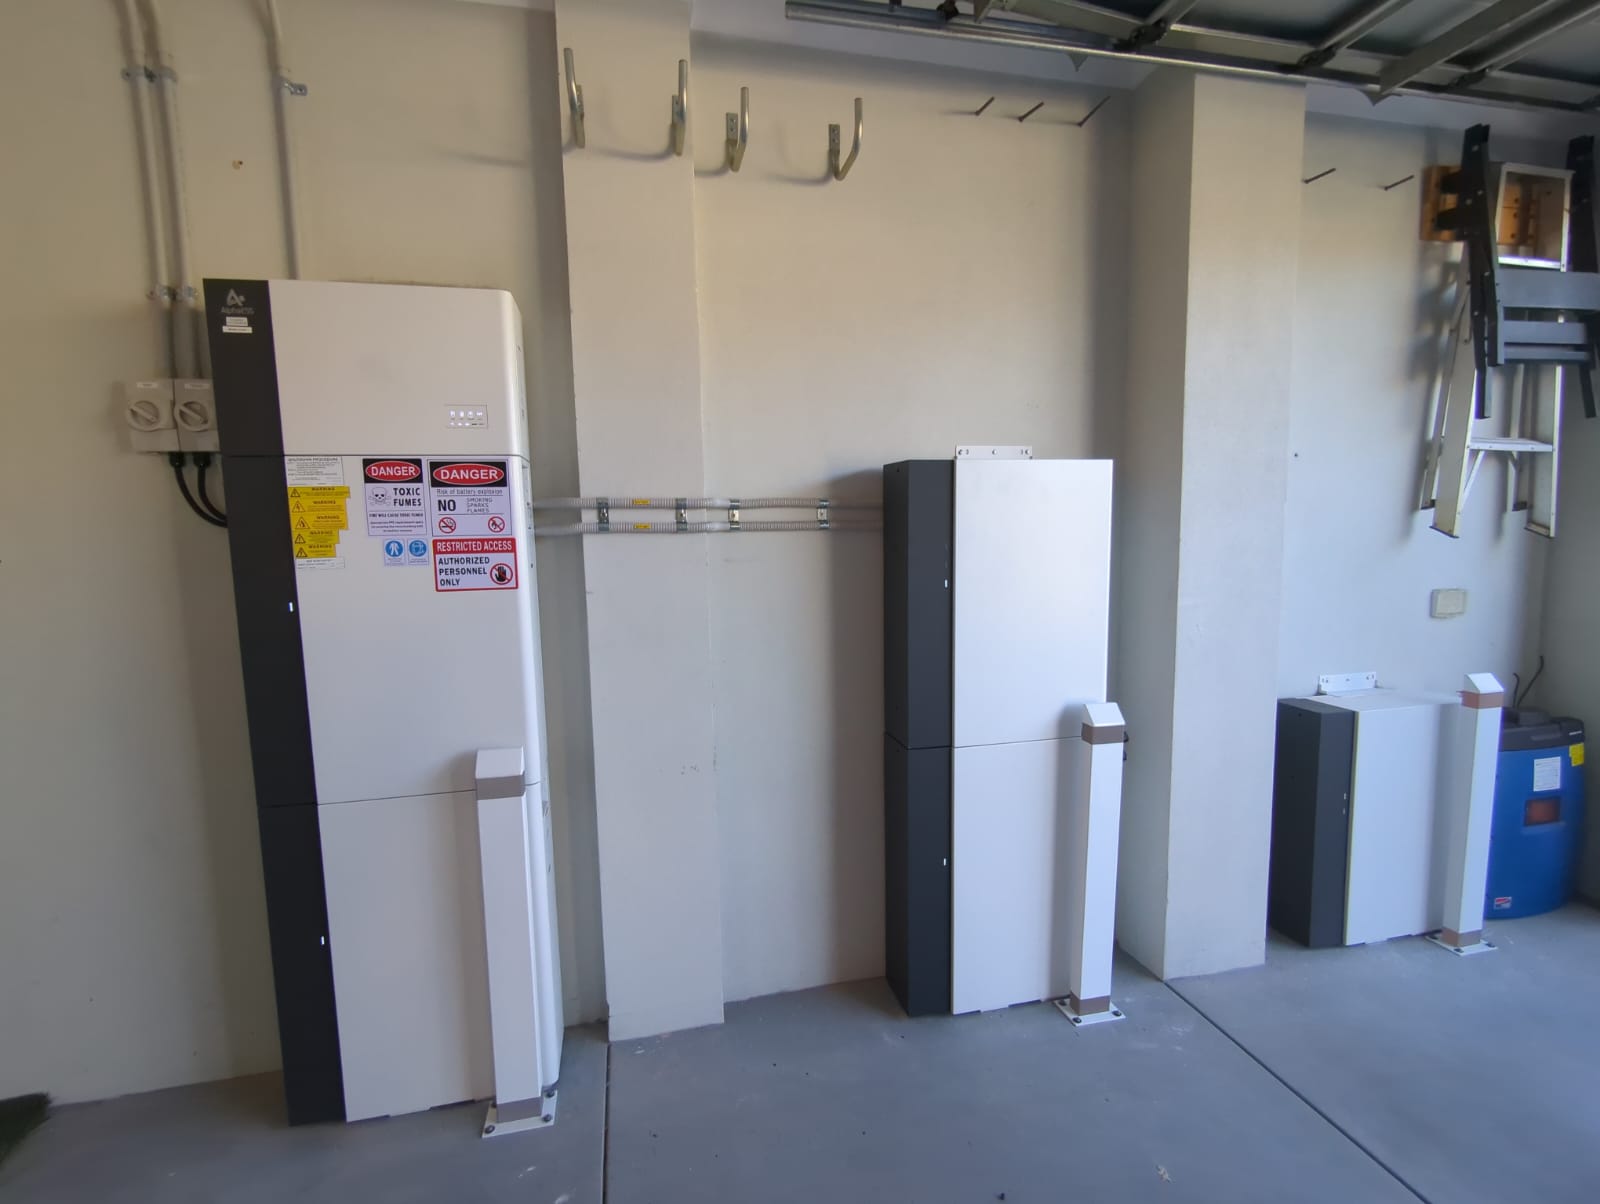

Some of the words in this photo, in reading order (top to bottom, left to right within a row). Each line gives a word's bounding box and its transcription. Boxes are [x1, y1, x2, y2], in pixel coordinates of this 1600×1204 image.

[371, 466, 416, 476] DANGER
[440, 469, 498, 480] DANGER
[393, 487, 421, 496] TOXIC
[457, 488, 476, 497] battery
[477, 488, 503, 496] explosion
[393, 498, 421, 507] FUMES
[438, 499, 457, 512] NO
[437, 542, 482, 552] RESTRICTED
[483, 540, 512, 551] ACCESS
[438, 556, 490, 566] AUTHORIZED
[439, 567, 487, 576] PERSONNEL
[440, 578, 460, 587] ONLY
